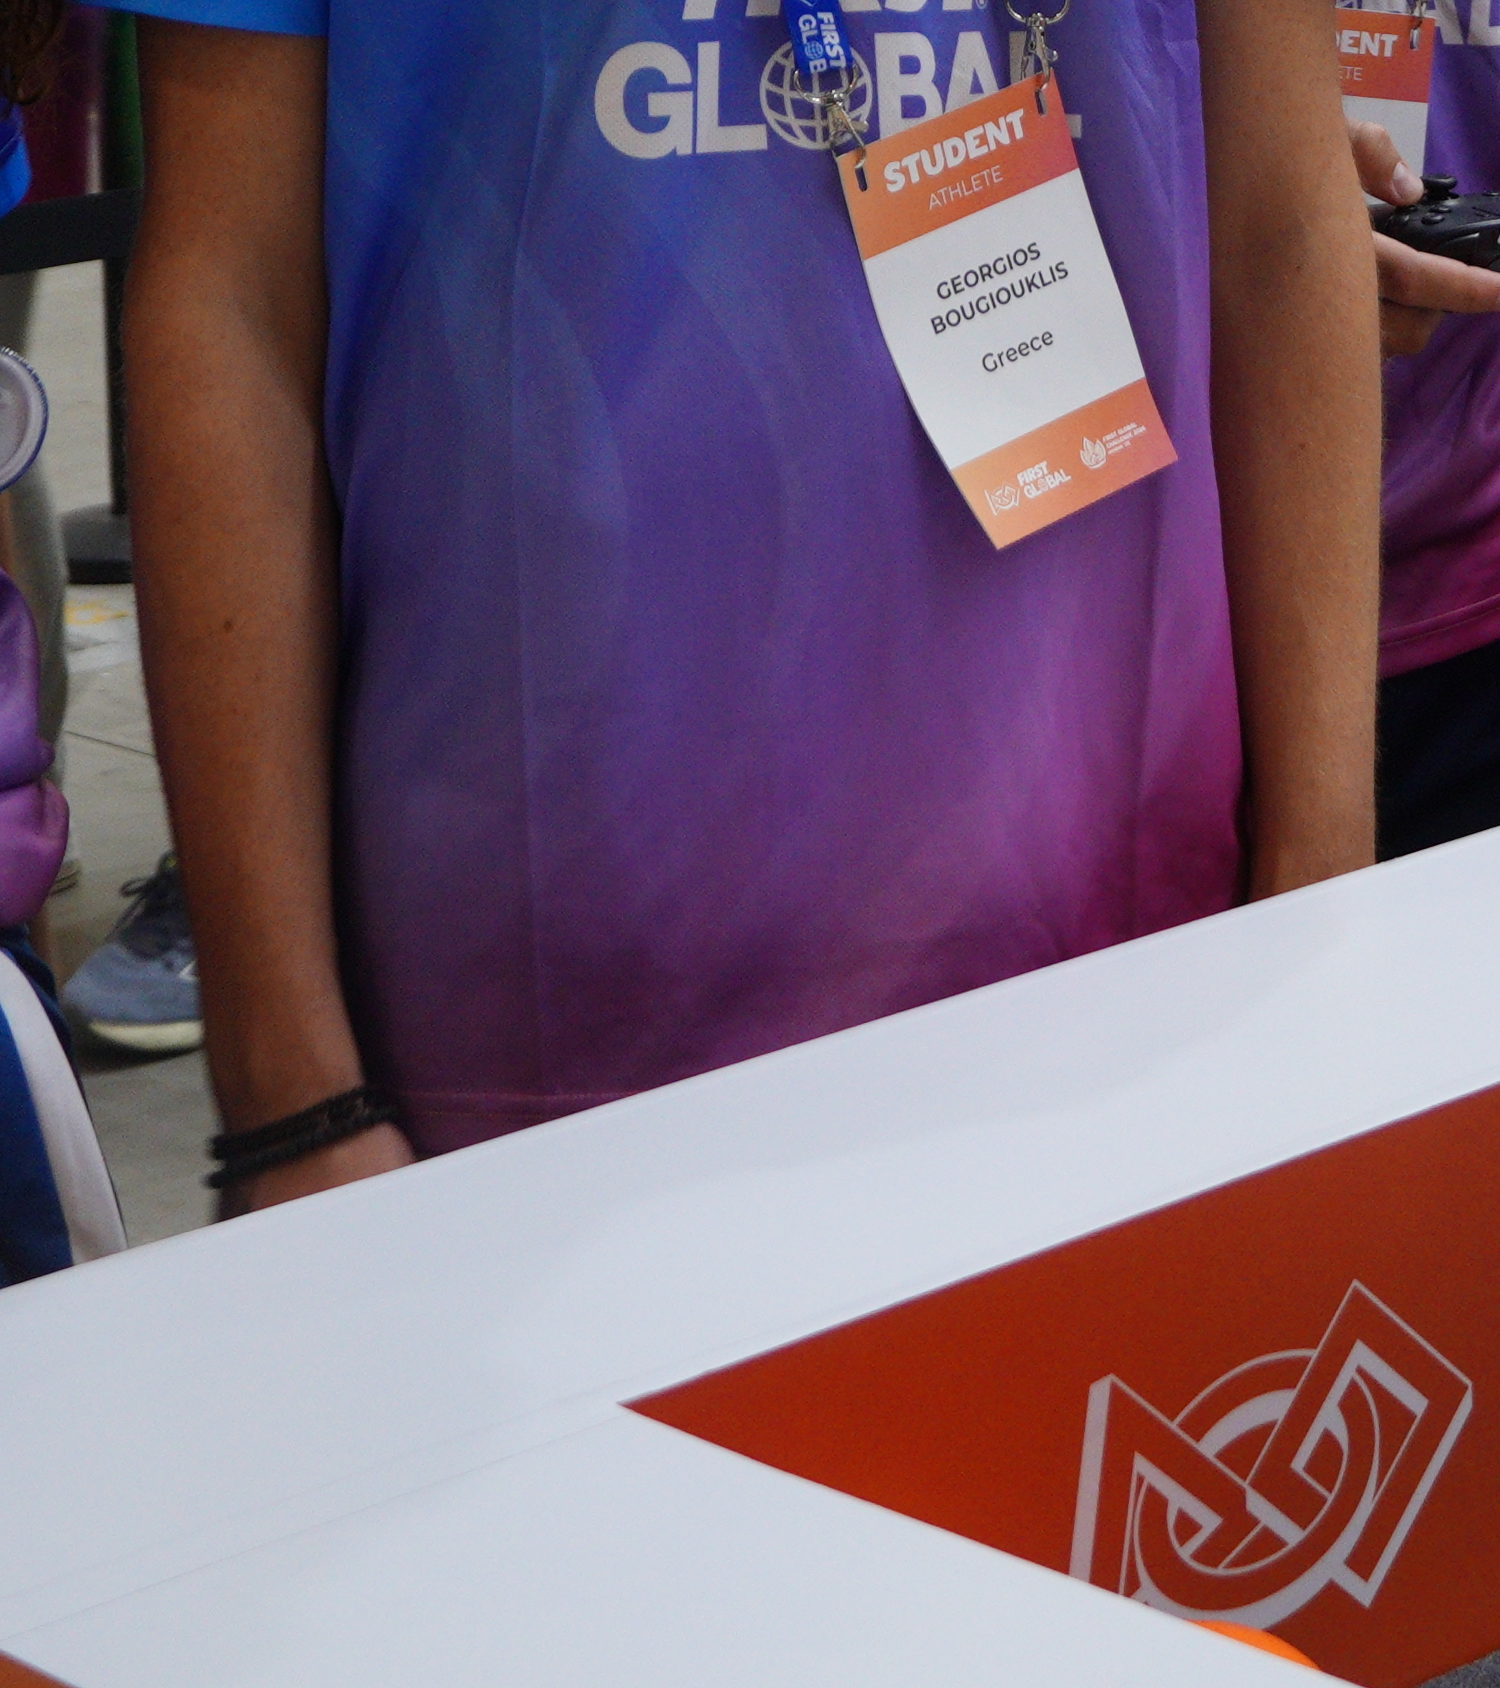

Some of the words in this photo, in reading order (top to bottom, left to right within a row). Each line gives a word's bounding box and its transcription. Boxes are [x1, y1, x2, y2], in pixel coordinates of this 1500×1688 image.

[798, 13, 827, 74] GLOB
[817, 11, 846, 70] FIRST
[594, 30, 1083, 160] GLOBA
[882, 108, 1025, 194] STUDENT
[928, 165, 1003, 211] ATHLETE
[930, 260, 1070, 335] BOUGIOUKLIS
[936, 242, 1041, 300] GEORGIOS
[981, 329, 1054, 374] Greece
[1016, 460, 1049, 486] FIRST
[1023, 468, 1072, 499] GLOBAL
